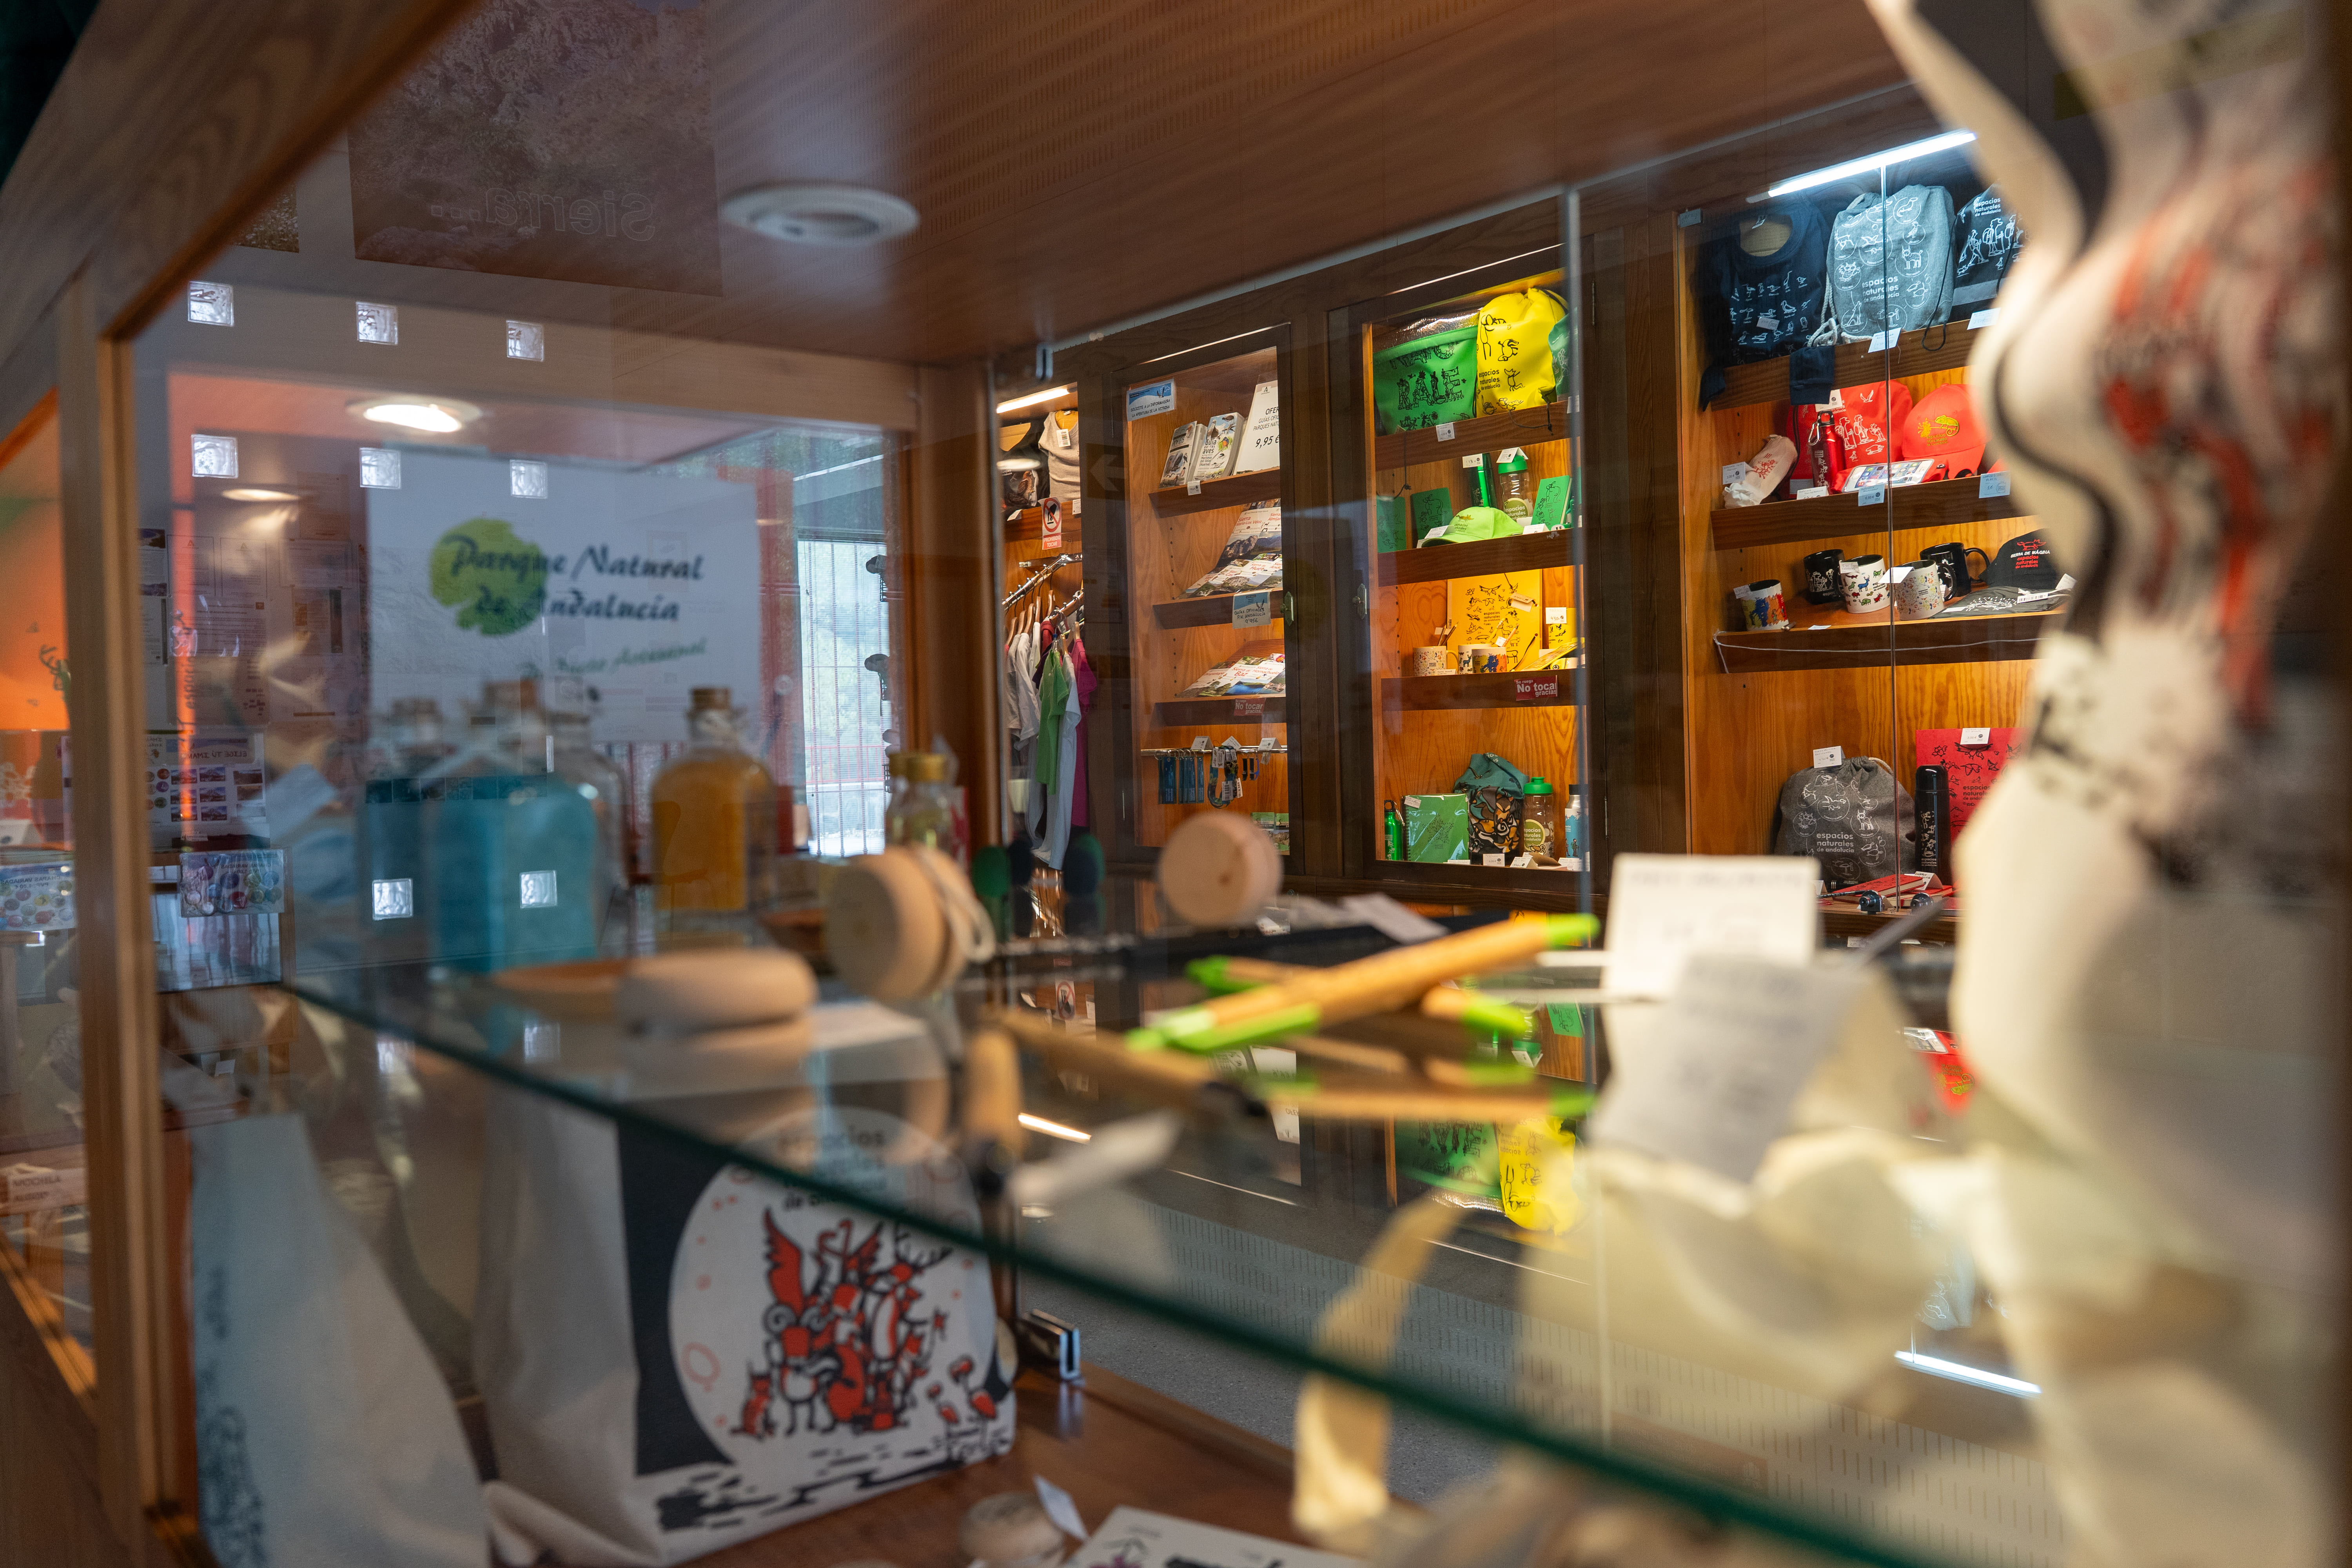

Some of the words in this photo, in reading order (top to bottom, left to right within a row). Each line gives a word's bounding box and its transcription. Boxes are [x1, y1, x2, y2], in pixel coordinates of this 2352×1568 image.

[1479, 368, 1499, 378] espacios
[1480, 376, 1500, 385] naturales
[1151, 399, 1170, 407] INFORMADORA
[1253, 423, 1269, 431] PARQUES
[1255, 436, 1274, 449] 9,95
[441, 534, 567, 583] Parque
[570, 544, 704, 581] Natural
[1517, 684, 1531, 693] No
